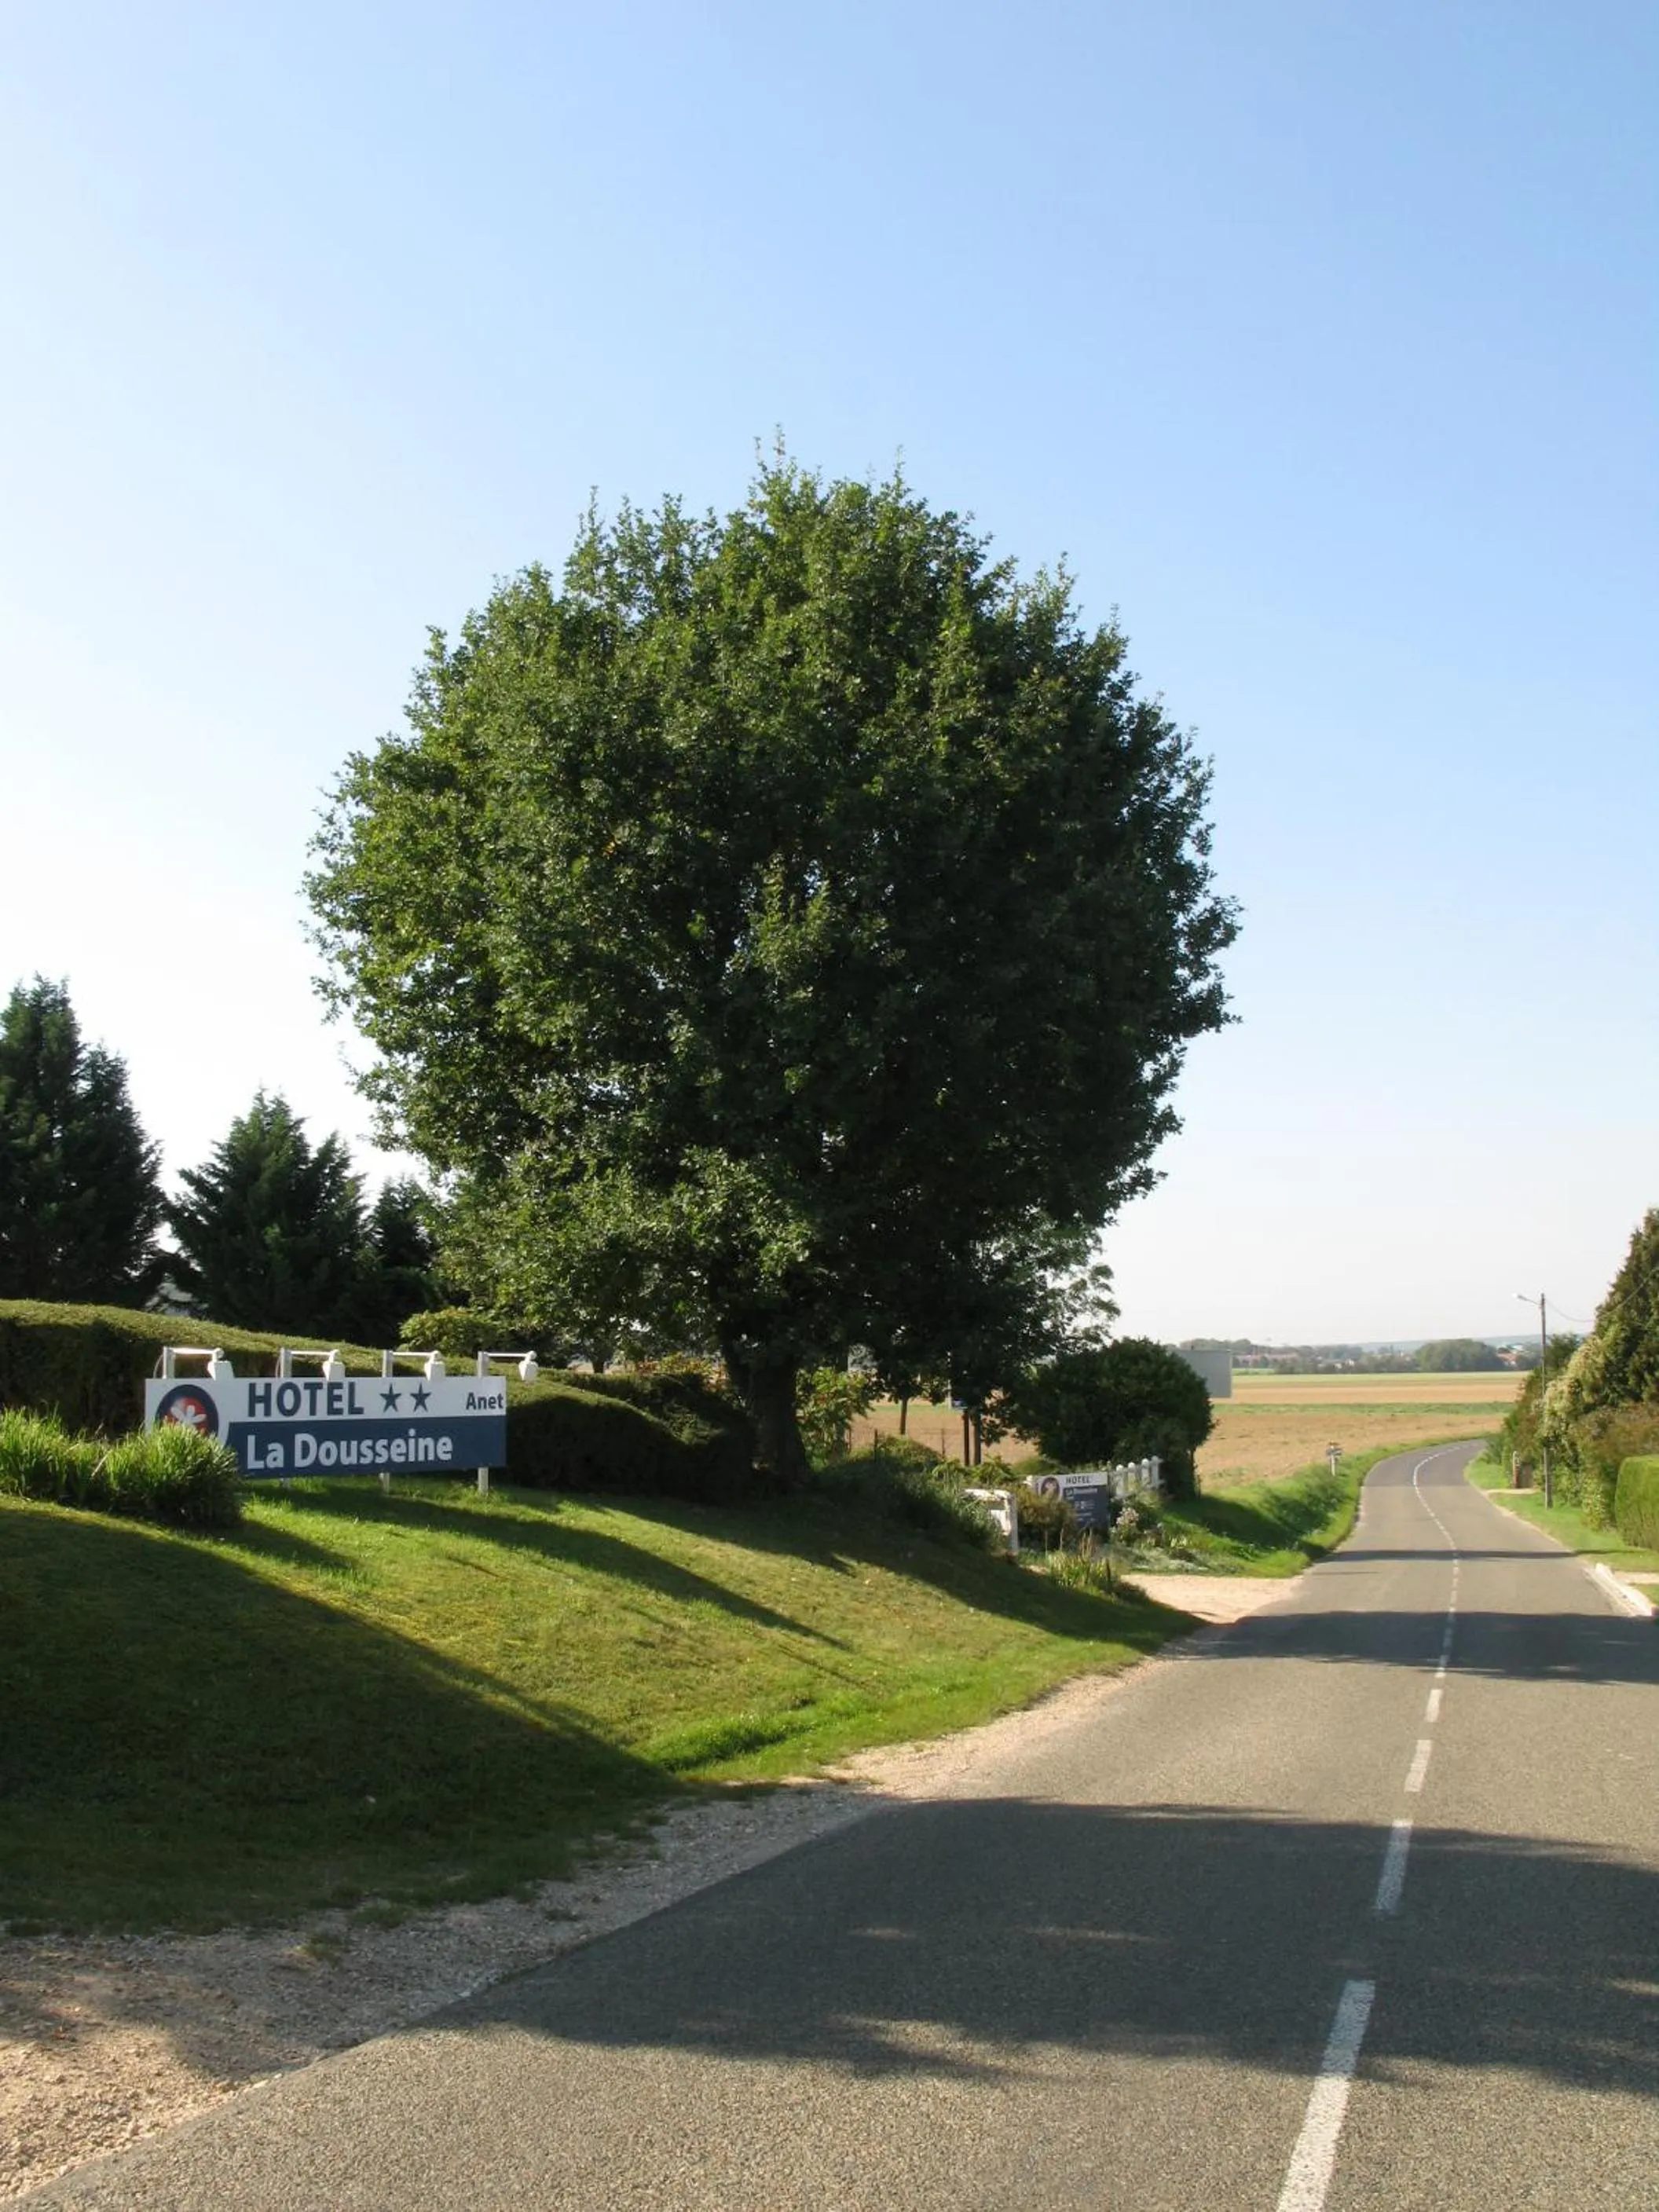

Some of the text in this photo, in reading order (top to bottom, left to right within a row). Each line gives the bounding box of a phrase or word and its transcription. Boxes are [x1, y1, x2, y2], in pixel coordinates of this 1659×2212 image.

[248, 1382, 364, 1417] HOTEL
[466, 1392, 504, 1410] Anet
[247, 1428, 452, 1469] La Dousseine
